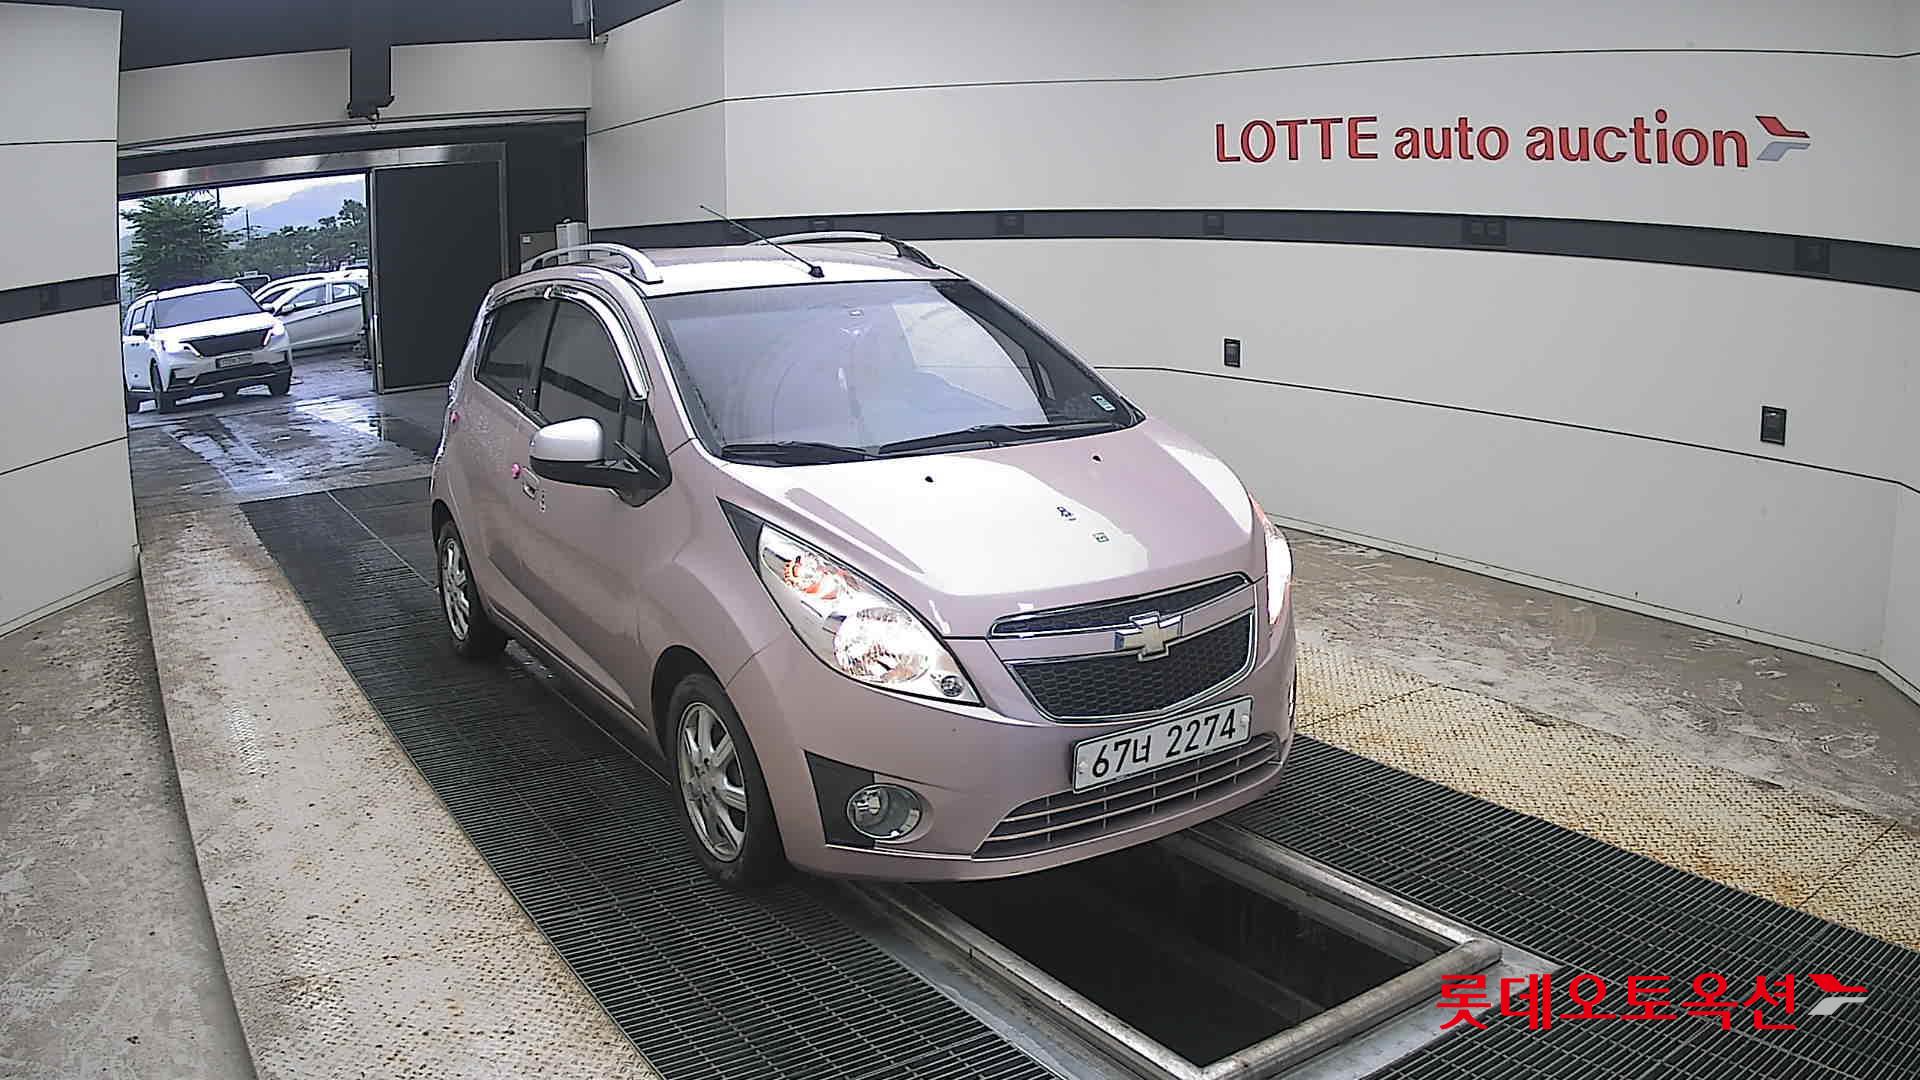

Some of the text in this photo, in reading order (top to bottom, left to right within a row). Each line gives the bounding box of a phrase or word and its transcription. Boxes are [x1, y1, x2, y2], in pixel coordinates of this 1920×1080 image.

[1216, 109, 1750, 168] LOTTE auto auction
[1092, 708, 1236, 777] 67너 2274
